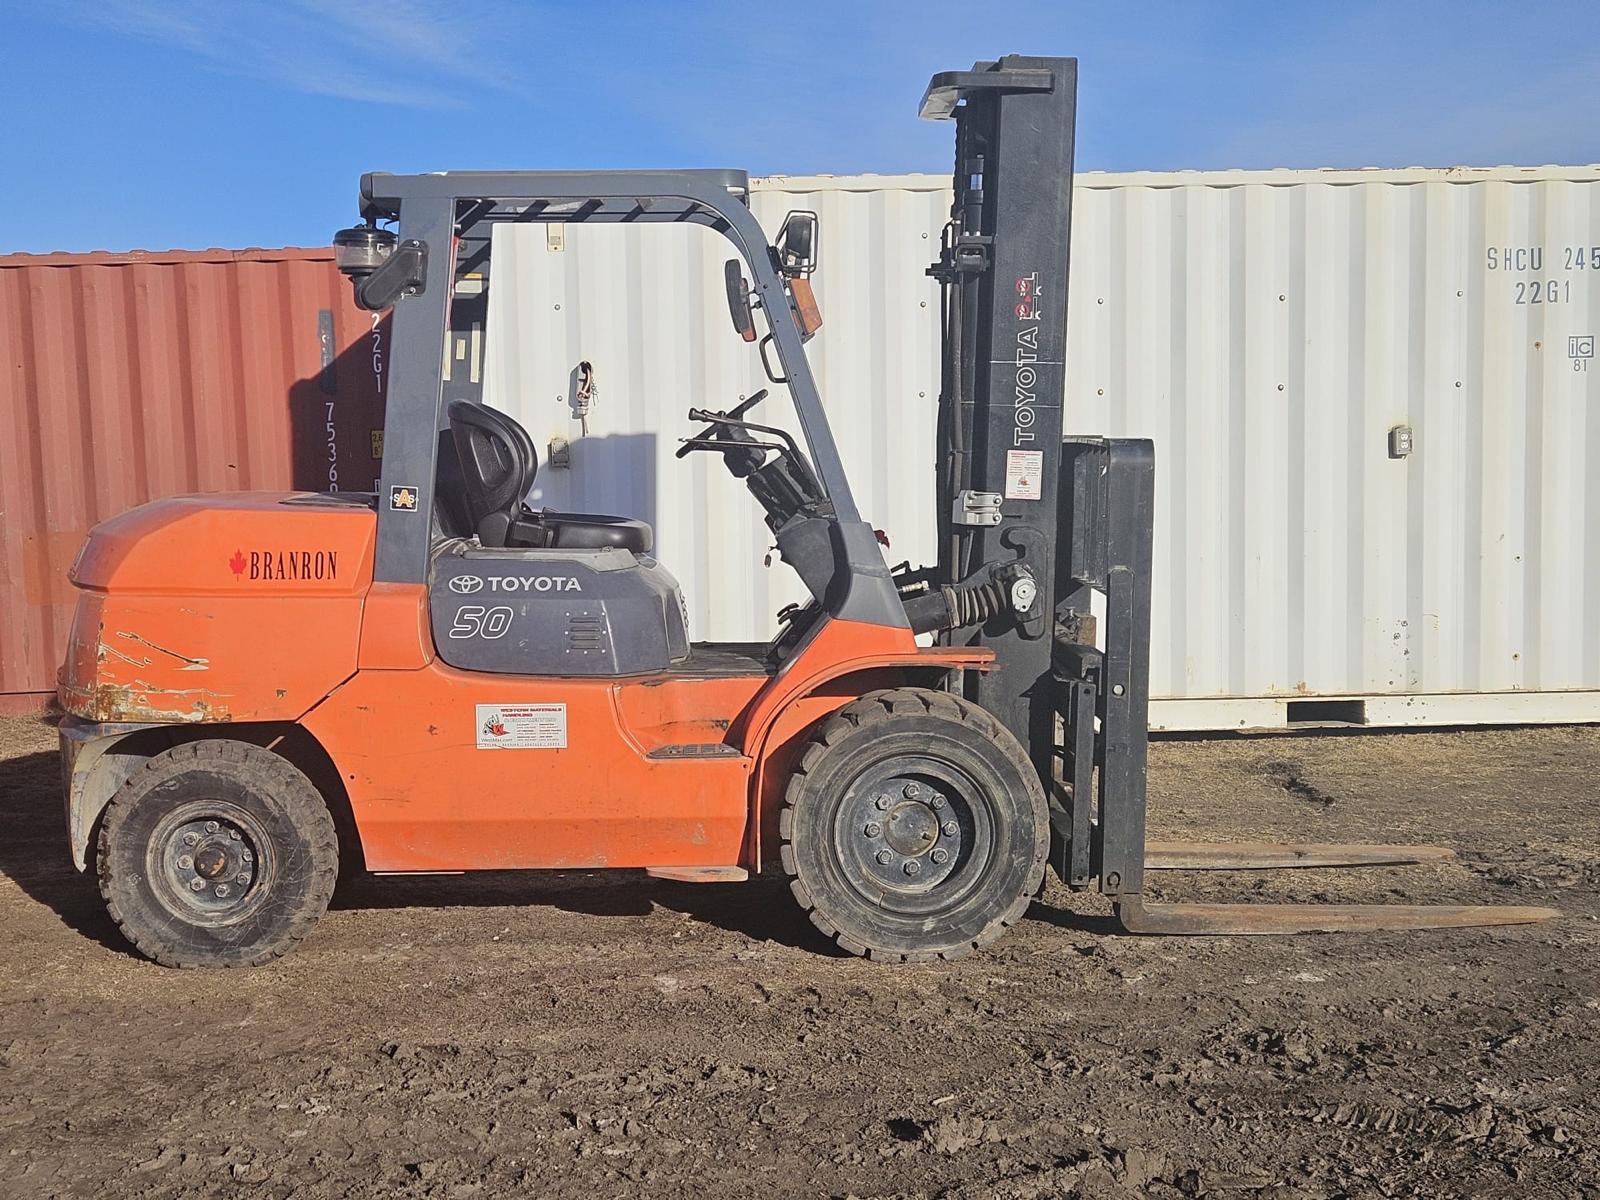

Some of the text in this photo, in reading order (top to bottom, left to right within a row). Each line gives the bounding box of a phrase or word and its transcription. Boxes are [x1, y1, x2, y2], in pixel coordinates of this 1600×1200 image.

[1487, 247, 1600, 271] SHCU 245
[1515, 280, 1570, 304] 22G1
[371, 313, 382, 393] 22G1
[1573, 359, 1587, 372] 81
[1014, 326, 1038, 446] TOYOTA
[249, 551, 338, 580] BRANRON
[487, 576, 582, 592] TOYOTA
[448, 605, 514, 640] 50
